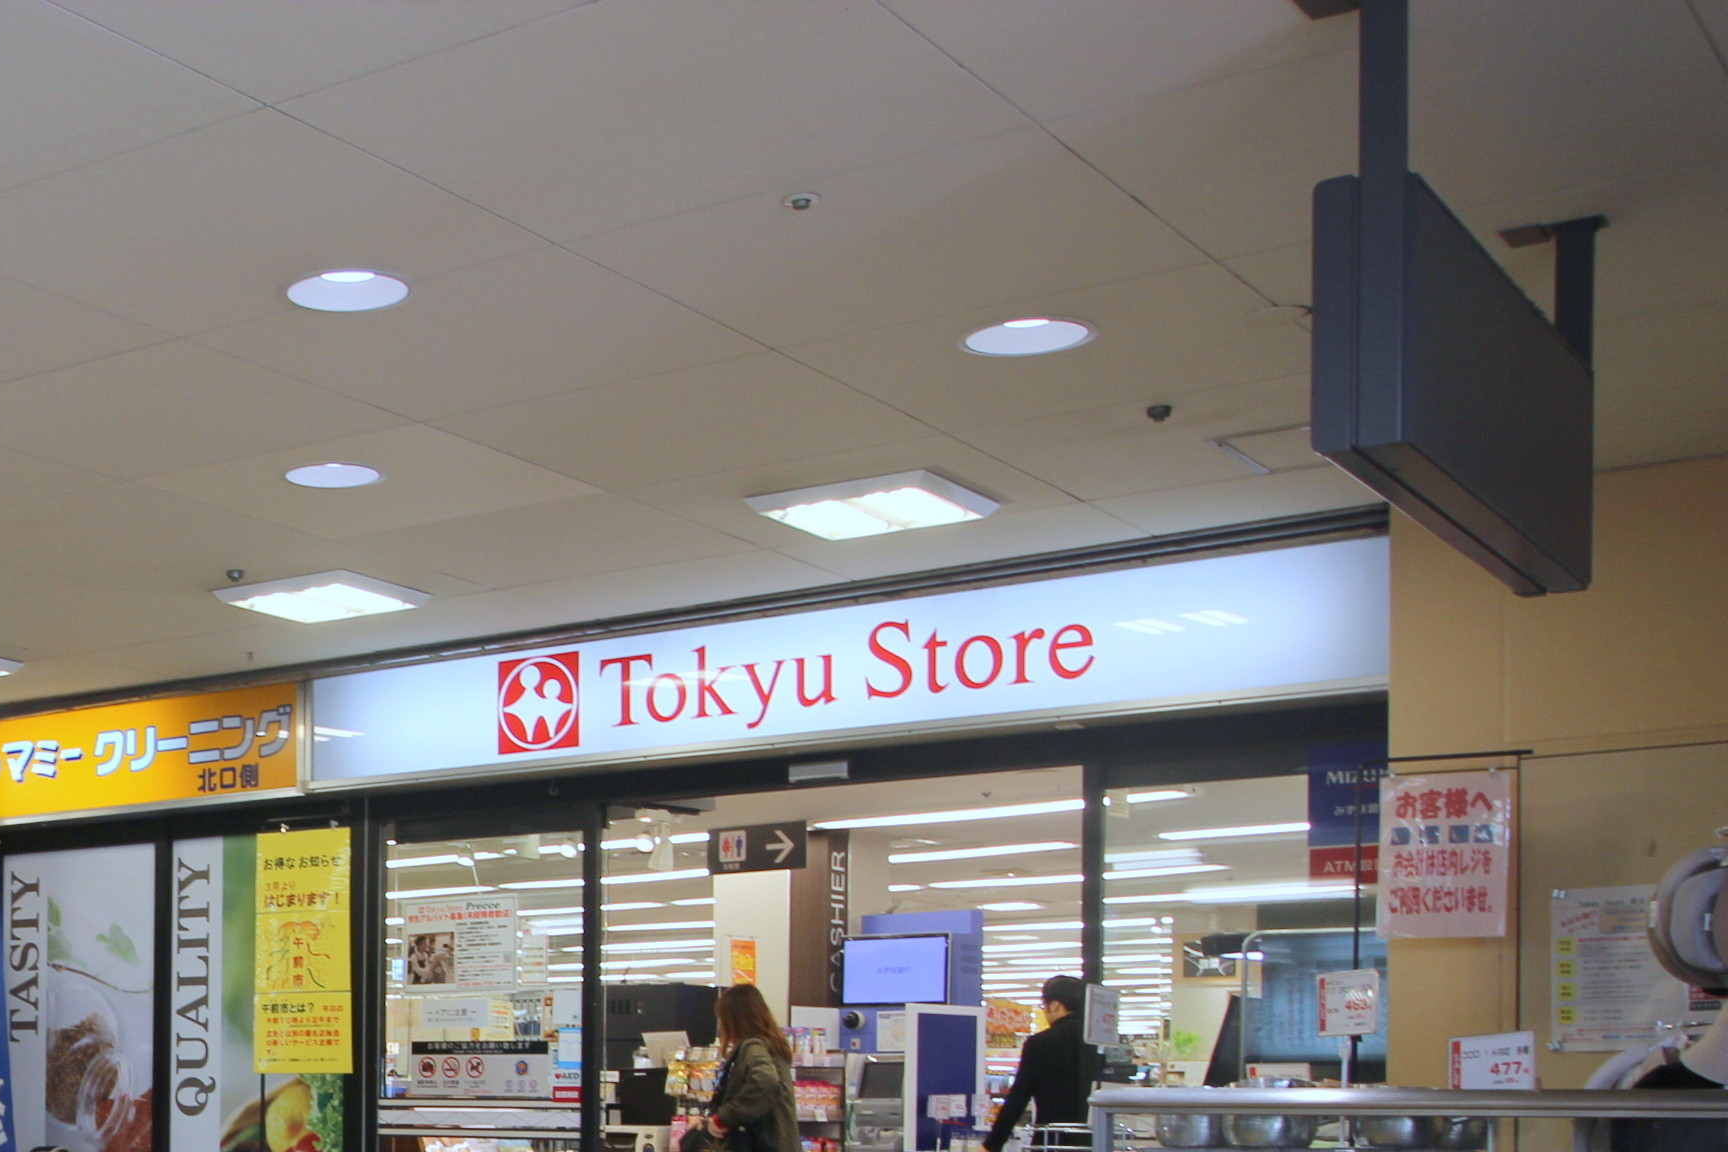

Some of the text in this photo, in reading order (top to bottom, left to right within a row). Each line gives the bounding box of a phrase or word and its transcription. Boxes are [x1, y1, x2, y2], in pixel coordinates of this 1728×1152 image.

[599, 618, 1096, 730] Tokyu Store
[1, 703, 293, 783] マミー クリーニング
[197, 762, 260, 793] 北口側
[1394, 786, 1493, 820] お客様へ
[9, 870, 40, 1043] TASTY
[175, 856, 217, 1117] QUALITY
[561, 1072, 580, 1080] AED
